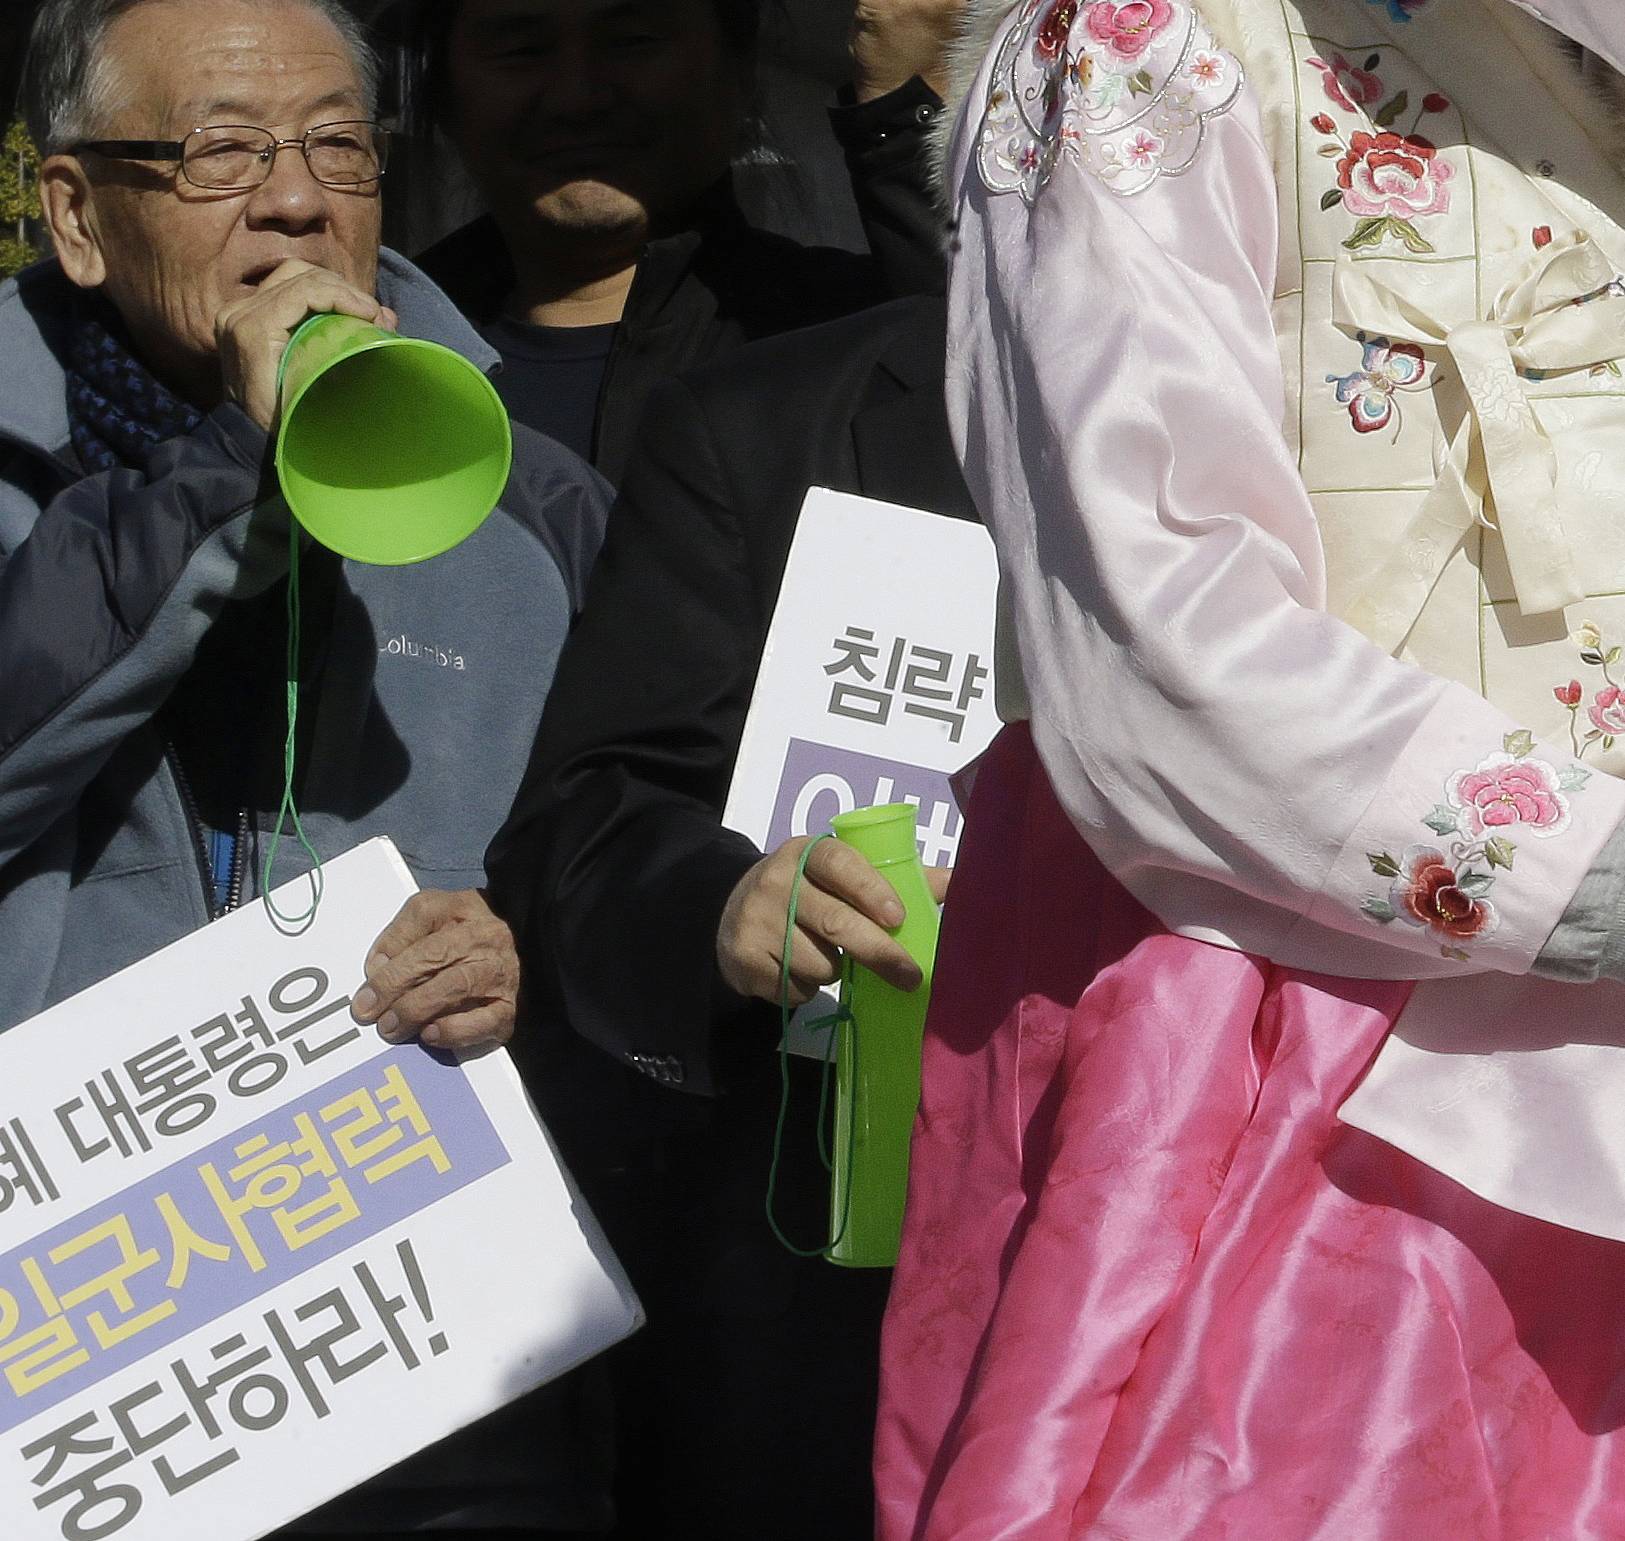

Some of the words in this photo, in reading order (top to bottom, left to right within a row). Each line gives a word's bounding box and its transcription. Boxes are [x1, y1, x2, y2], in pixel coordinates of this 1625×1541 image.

[822, 626, 988, 744] 침략
[54, 966, 363, 1163] 대통령은
[0, 1064, 453, 1398] 일군사협력
[20, 1238, 450, 1541] 중단하라!
